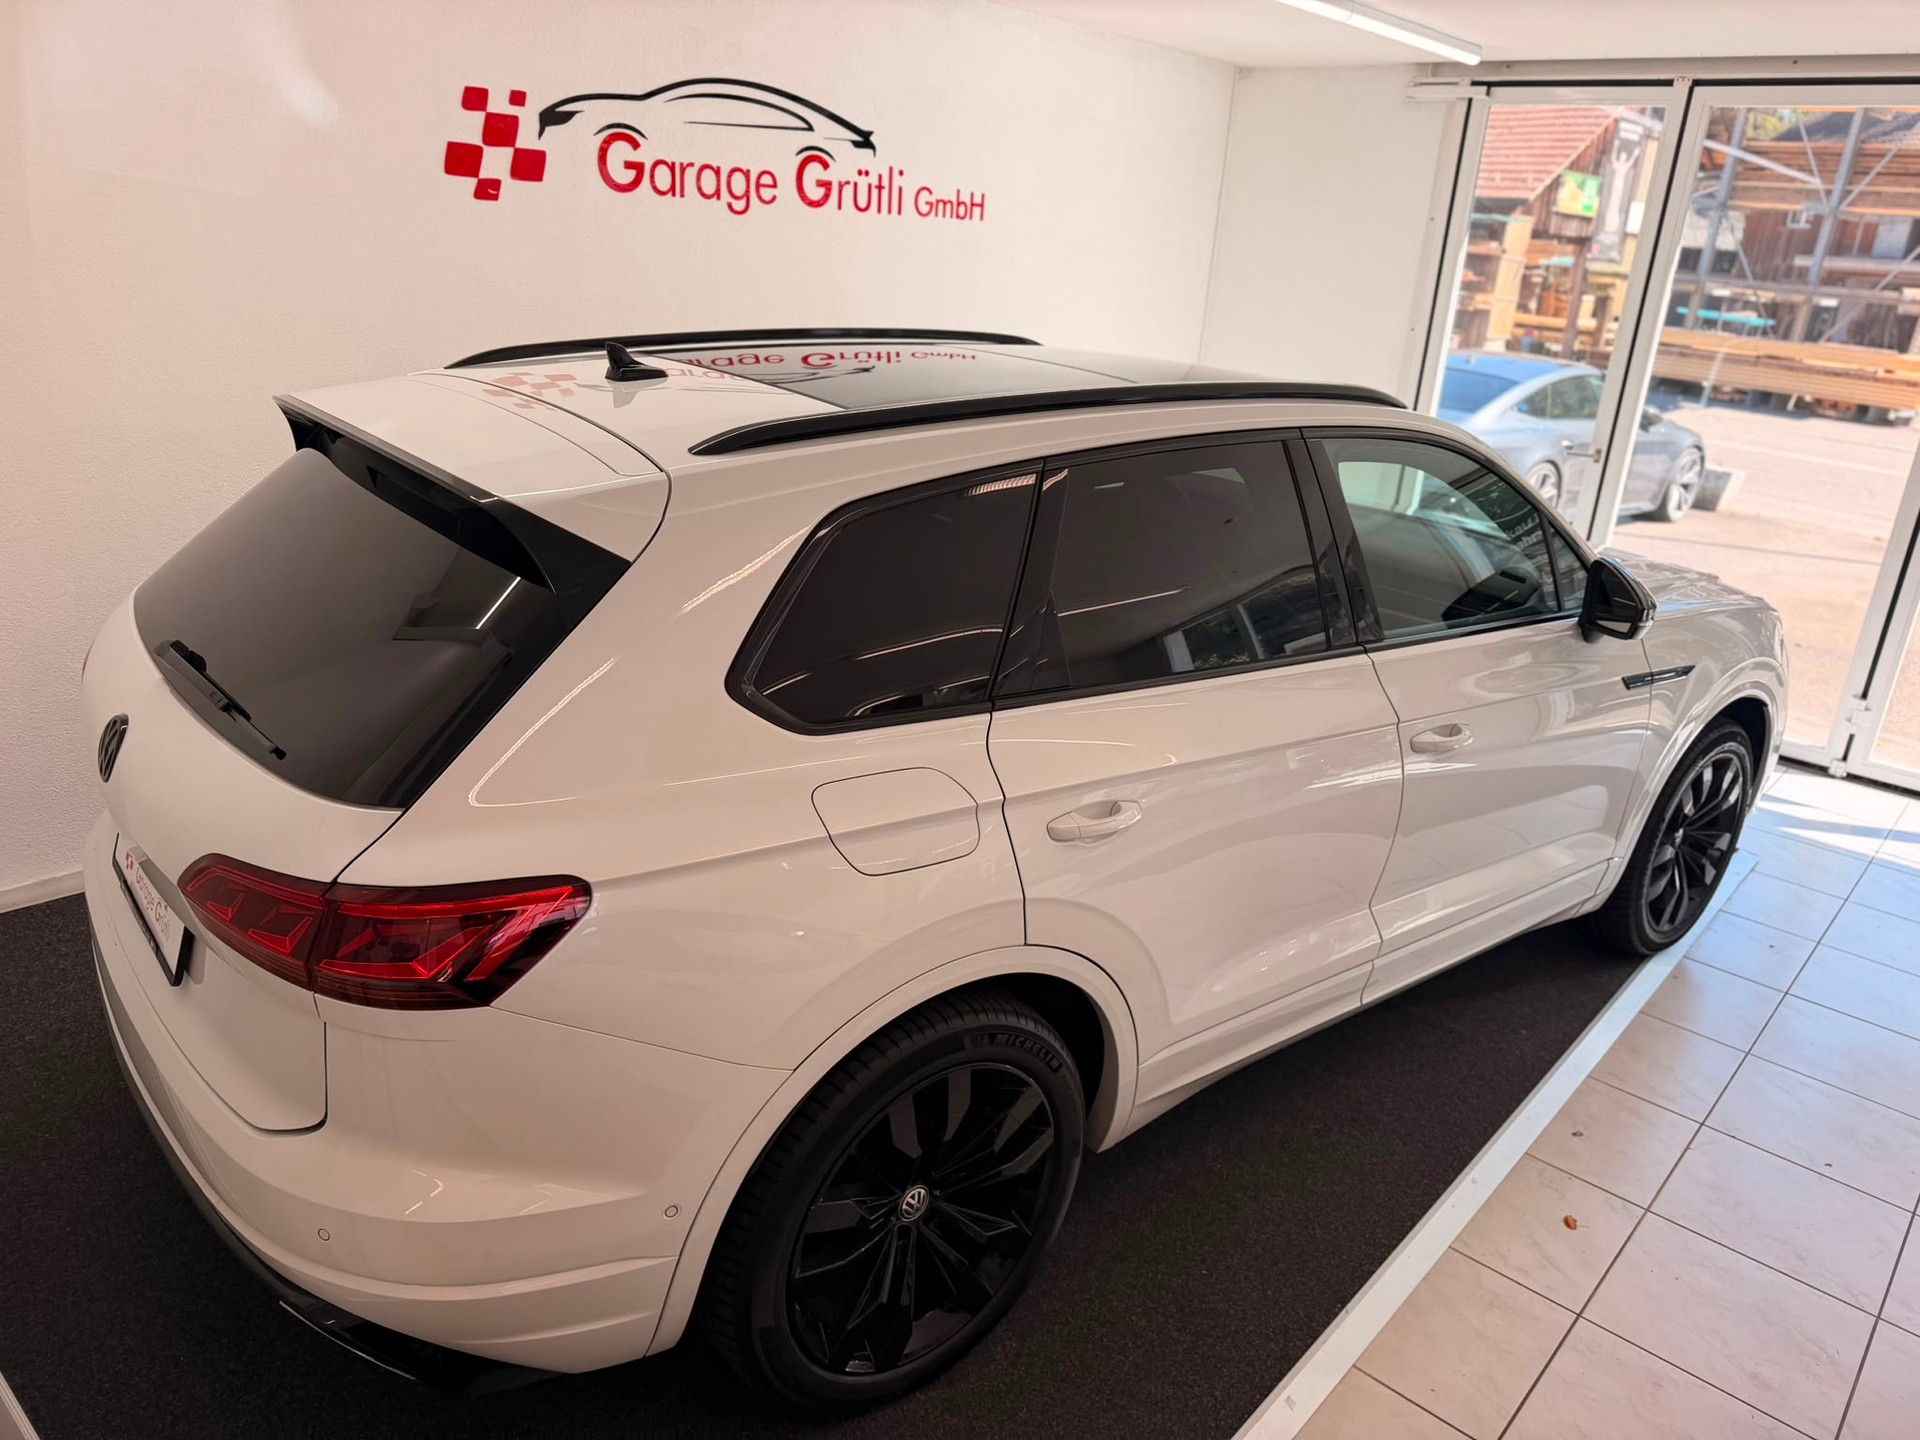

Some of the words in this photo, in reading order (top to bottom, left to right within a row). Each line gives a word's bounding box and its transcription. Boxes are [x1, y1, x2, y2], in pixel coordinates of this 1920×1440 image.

[597, 131, 779, 216] Garage
[795, 153, 905, 216] Grütli
[913, 185, 986, 221] GmbH
[994, 1033, 1062, 1071] MICHELIN
